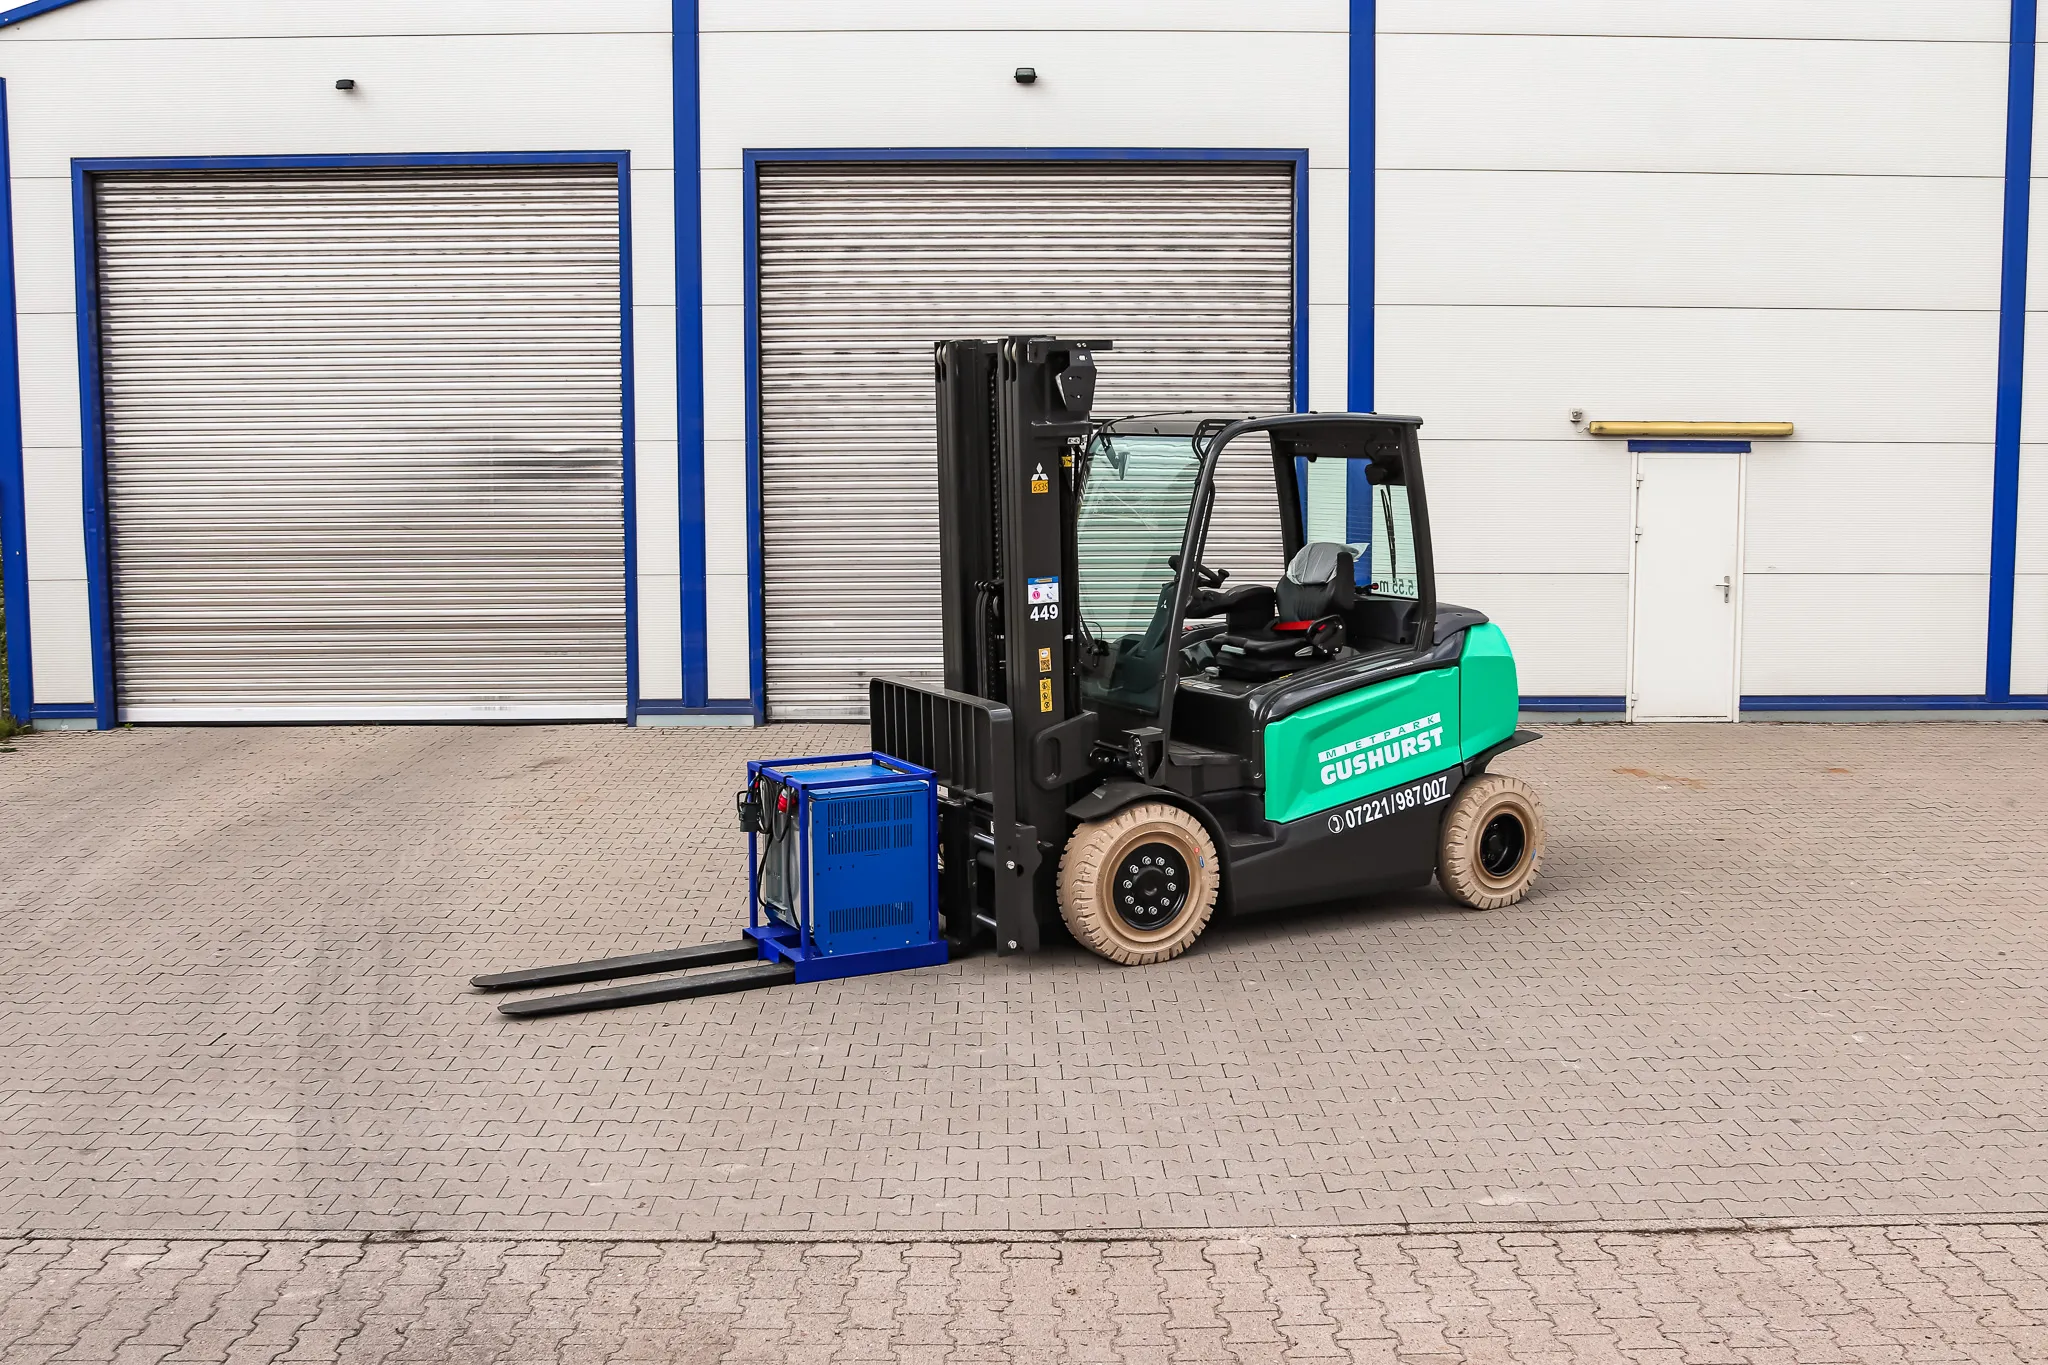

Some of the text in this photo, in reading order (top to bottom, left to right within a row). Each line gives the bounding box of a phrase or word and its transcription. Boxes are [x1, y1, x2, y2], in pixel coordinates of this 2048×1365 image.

[1030, 604, 1059, 621] 449
[1320, 726, 1444, 785] GUSHURST
[1325, 715, 1435, 760] MIETPARK
